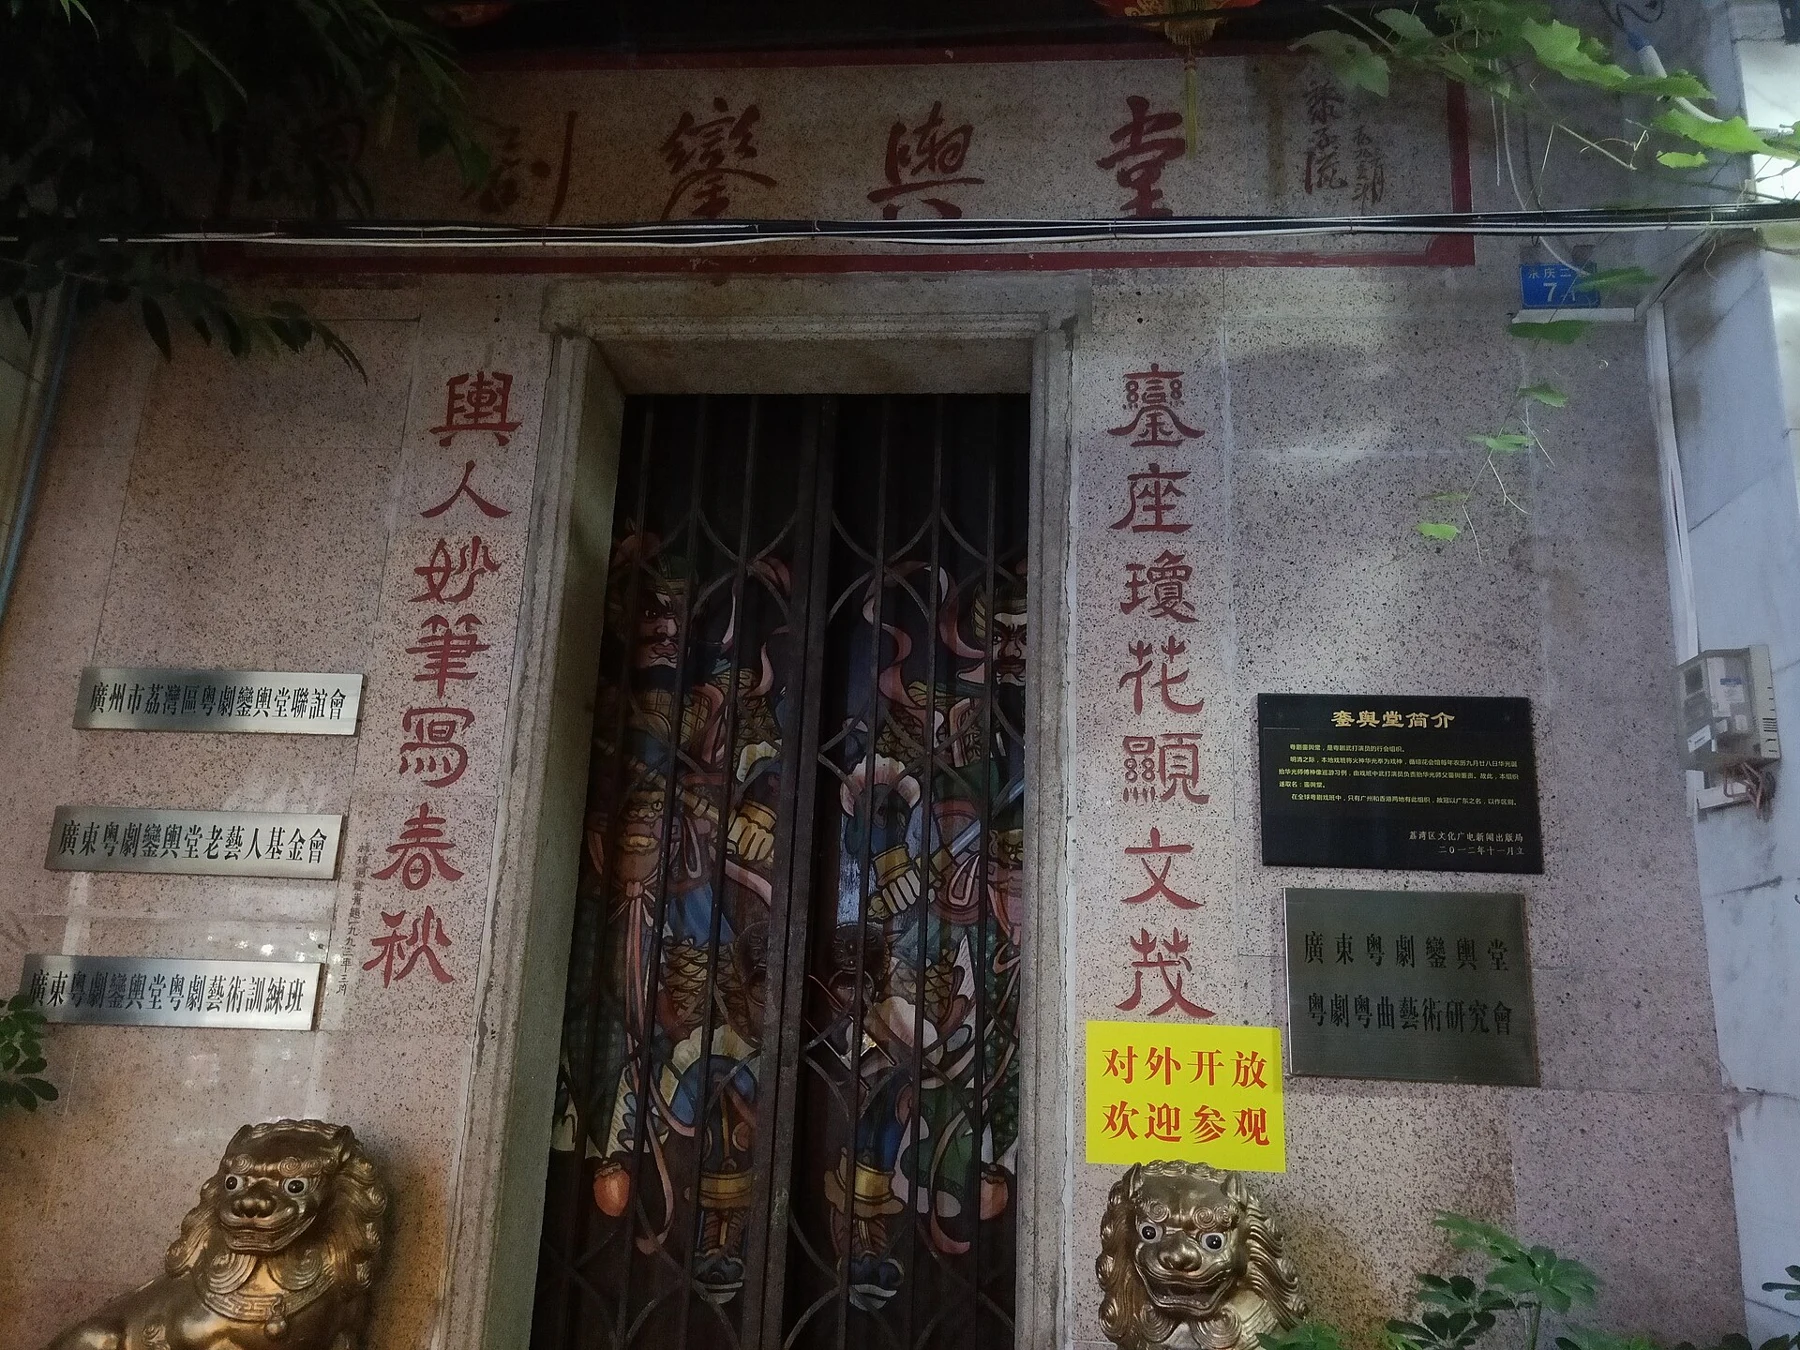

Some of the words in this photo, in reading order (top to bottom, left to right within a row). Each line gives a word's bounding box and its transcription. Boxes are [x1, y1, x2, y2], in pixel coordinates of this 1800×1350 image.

[1102, 1046, 1268, 1089] 对外开放
[1101, 1100, 1270, 1146] 欢迎参观
